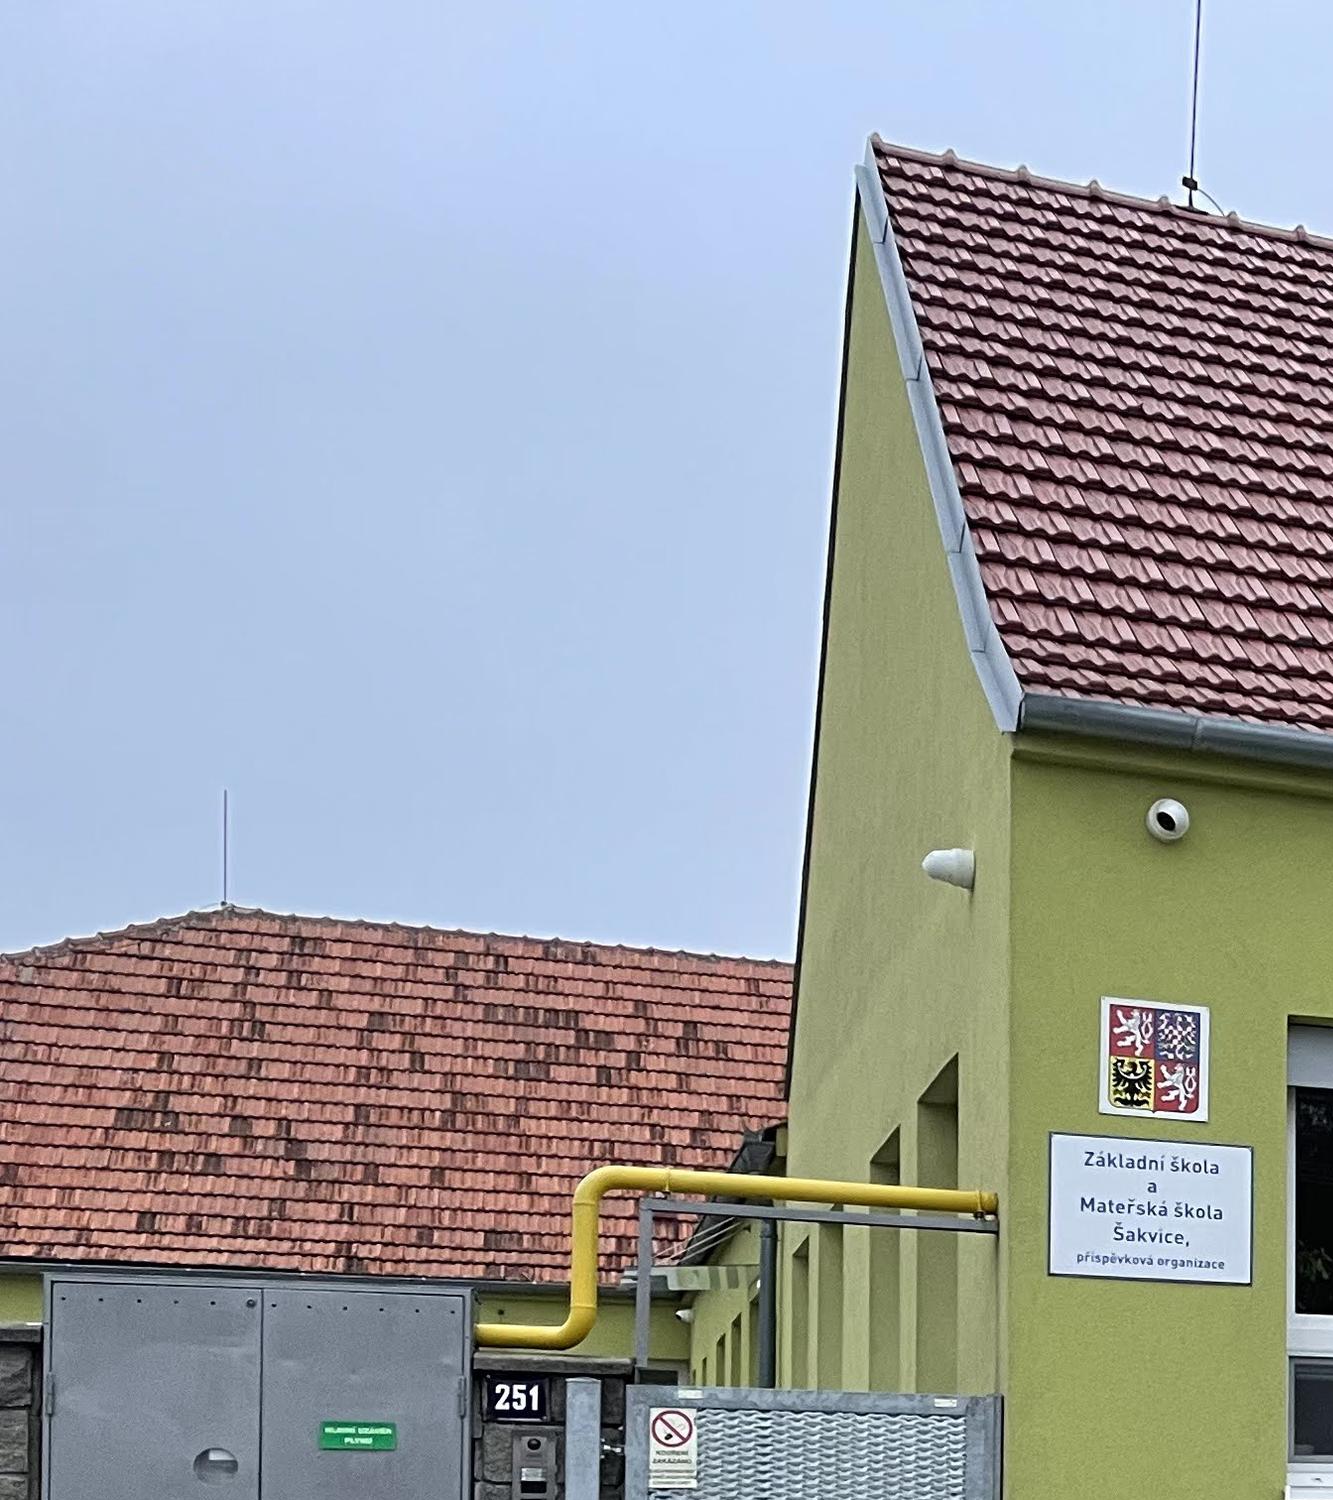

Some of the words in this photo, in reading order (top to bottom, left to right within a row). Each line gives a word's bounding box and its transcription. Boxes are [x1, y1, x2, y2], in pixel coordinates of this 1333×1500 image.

[1084, 1151, 1165, 1172] Základní
[1170, 1156, 1220, 1175] škola
[1147, 1182, 1157, 1193] a
[1080, 1197, 1168, 1217] Mateřská
[1174, 1202, 1223, 1220] škola
[1113, 1221, 1190, 1247] Šakvice,
[1076, 1251, 1154, 1266] příspěvková
[1157, 1257, 1225, 1270] organizace
[494, 1384, 539, 1411] 251
